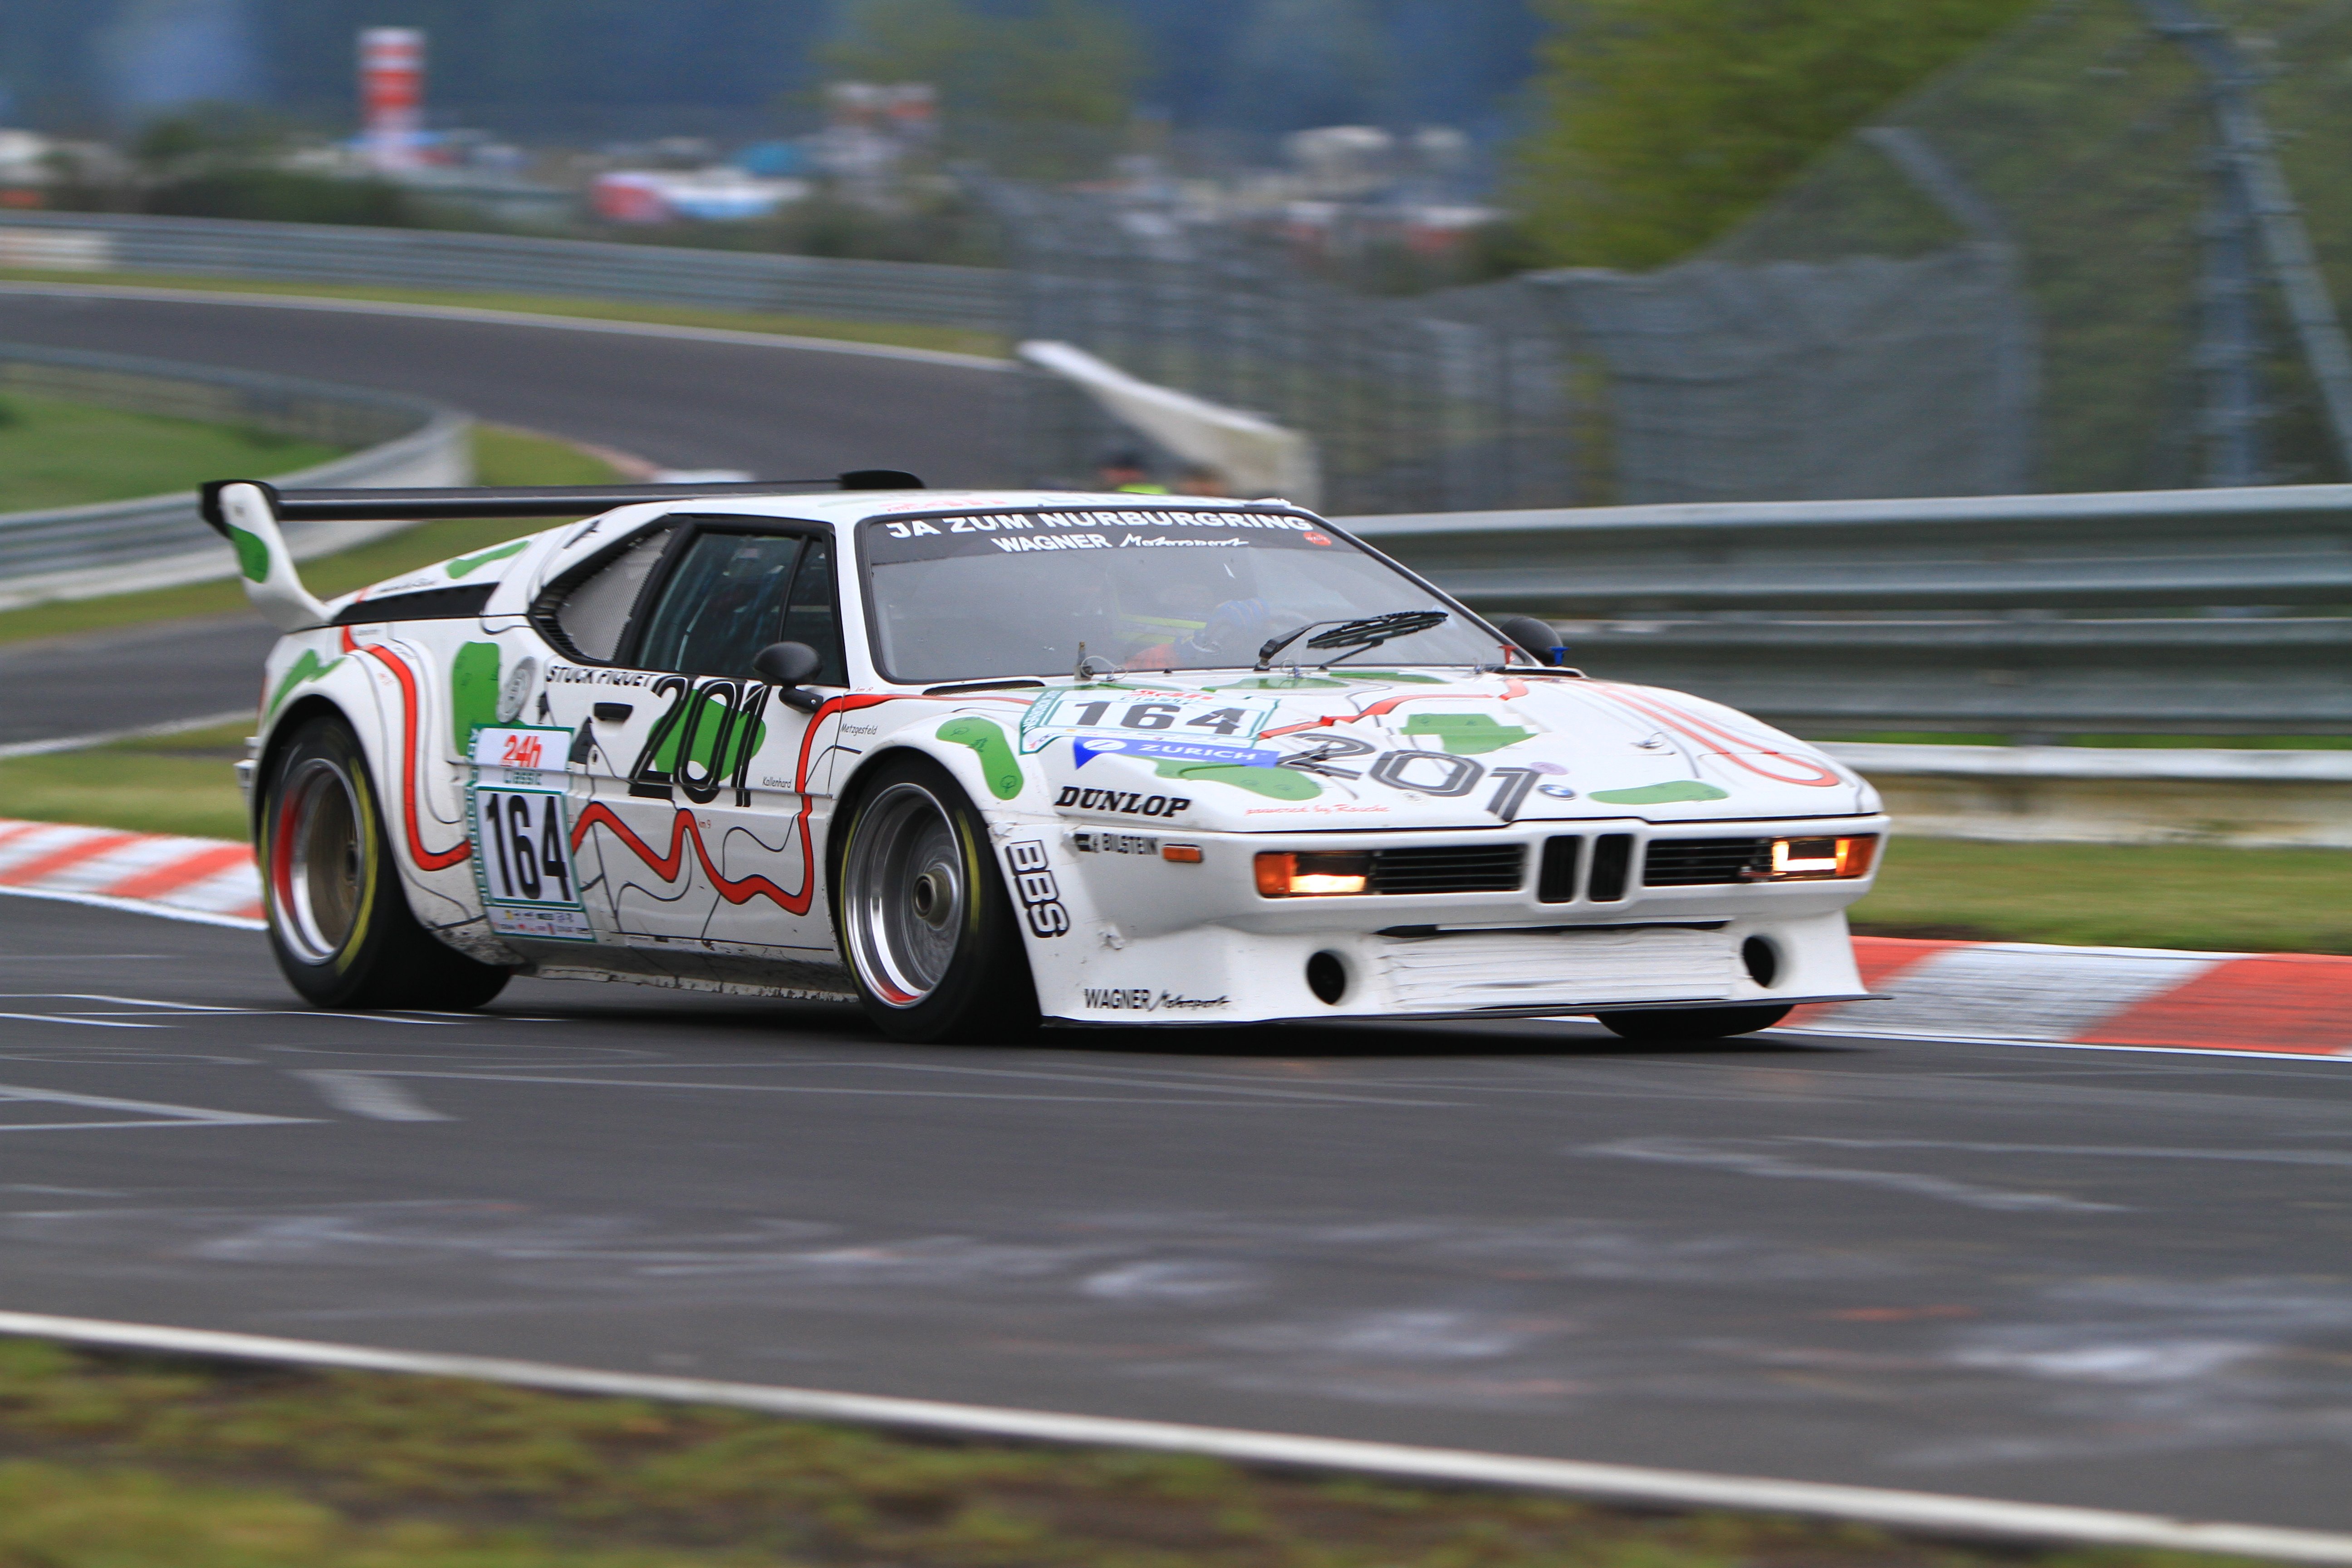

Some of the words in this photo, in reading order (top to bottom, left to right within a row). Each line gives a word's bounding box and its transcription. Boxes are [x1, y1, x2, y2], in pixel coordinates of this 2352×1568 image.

[886, 519, 941, 539] JA
[941, 513, 1034, 534] ZUM
[990, 533, 1112, 553] WAGNER
[546, 665, 598, 684] STUCK
[597, 668, 660, 688] PIQUET
[840, 723, 878, 736] Metzgesfeld
[1074, 701, 1246, 735] 164
[502, 735, 543, 768] 24h
[627, 674, 774, 808] 201
[1137, 744, 1258, 760] ZURICH
[762, 776, 792, 789] Kallenhard
[1275, 733, 1543, 822] 201
[1054, 785, 1191, 818] DUNLOP
[484, 793, 572, 902] 164
[1102, 833, 1159, 855] BILSTEIN
[1005, 839, 1070, 939] BBS
[1083, 988, 1151, 1010] WAGNER
